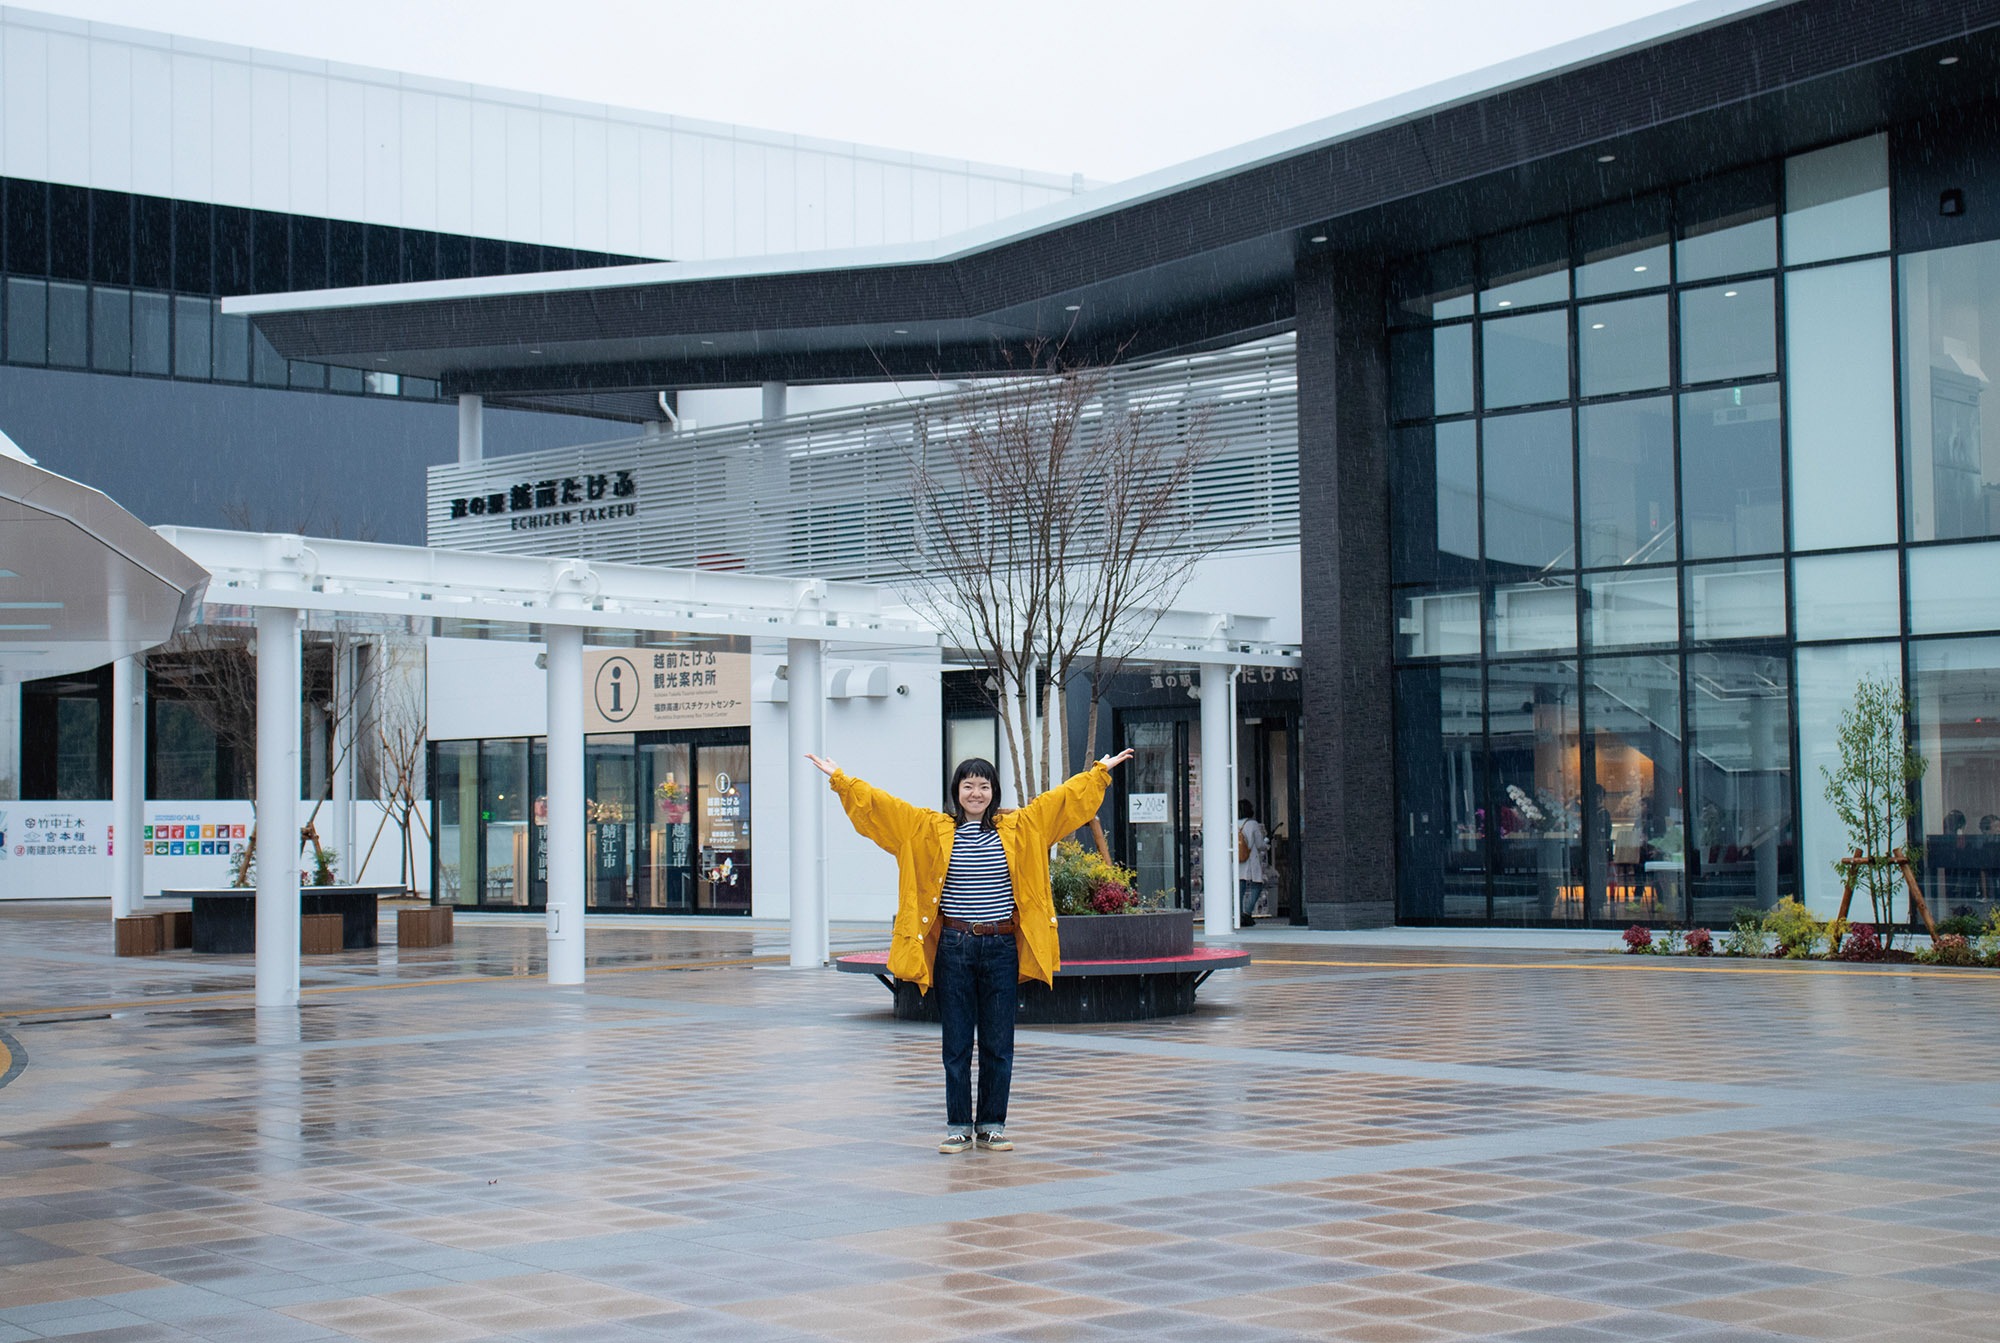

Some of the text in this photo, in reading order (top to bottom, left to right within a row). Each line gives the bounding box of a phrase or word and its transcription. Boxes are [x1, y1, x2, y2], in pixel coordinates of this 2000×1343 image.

[510, 503, 636, 531] ECHIZEN-TAKEFU
[653, 652, 716, 669] 越前たけふ
[653, 670, 716, 689] 観光案内所
[1150, 674, 1192, 689] 道の駅
[38, 818, 86, 829] 竹中土木
[26, 845, 97, 856] 南建設株式会社
[602, 824, 617, 868] 鯖江市
[671, 823, 687, 868] 越前市
